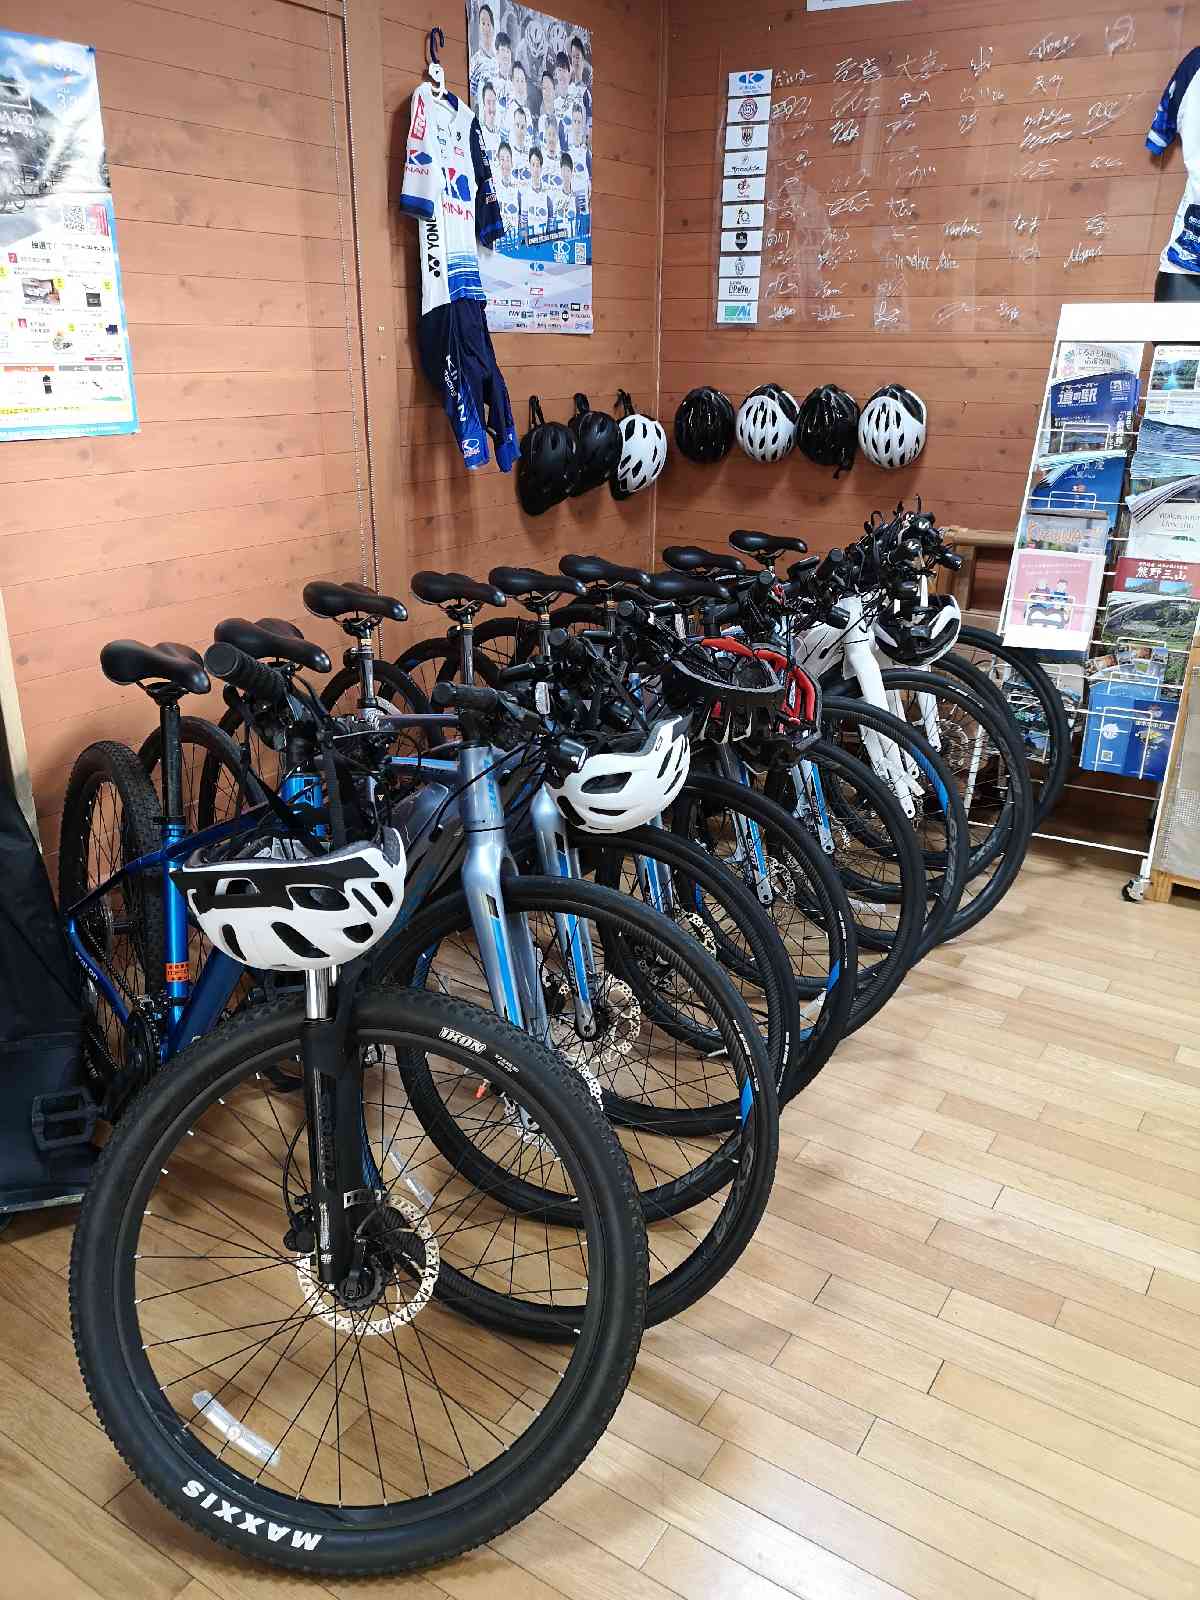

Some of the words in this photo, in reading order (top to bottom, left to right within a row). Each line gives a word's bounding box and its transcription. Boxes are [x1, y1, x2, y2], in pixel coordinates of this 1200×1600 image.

[1057, 387, 1098, 405] 道の駅
[1136, 566, 1187, 581] 熊野三山
[439, 1026, 487, 1054] IKON
[181, 1479, 323, 1551] MAXXIS
